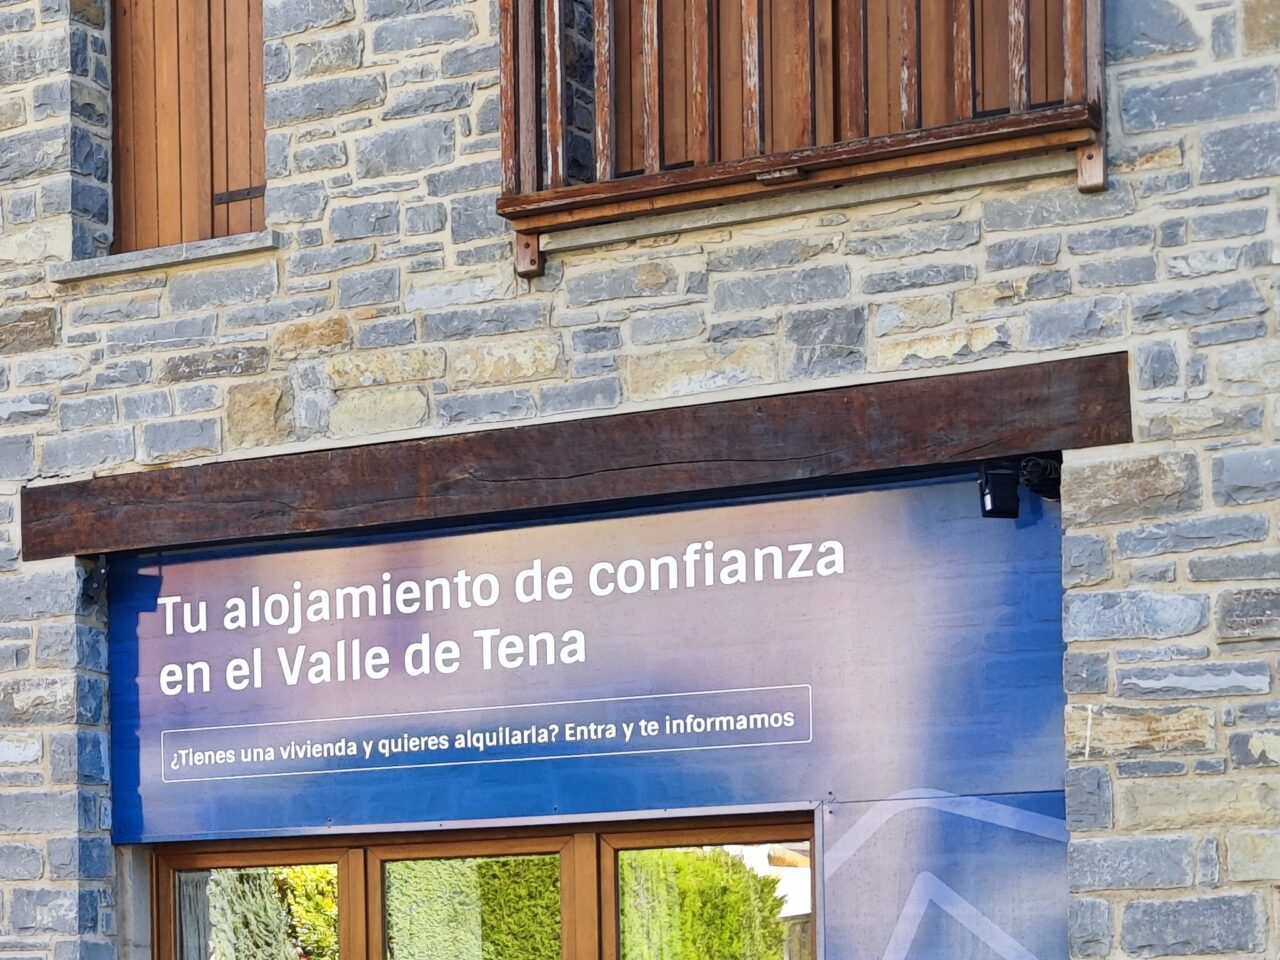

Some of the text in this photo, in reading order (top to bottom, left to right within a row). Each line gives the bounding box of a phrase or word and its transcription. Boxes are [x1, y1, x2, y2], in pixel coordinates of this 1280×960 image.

[157, 538, 845, 636] Tu alojamiento de confianza
[159, 628, 586, 696] en el Valle de Tena
[171, 711, 795, 770] ¿Tienes una vivienda y quieres alquilarla? Entra y te informamos
